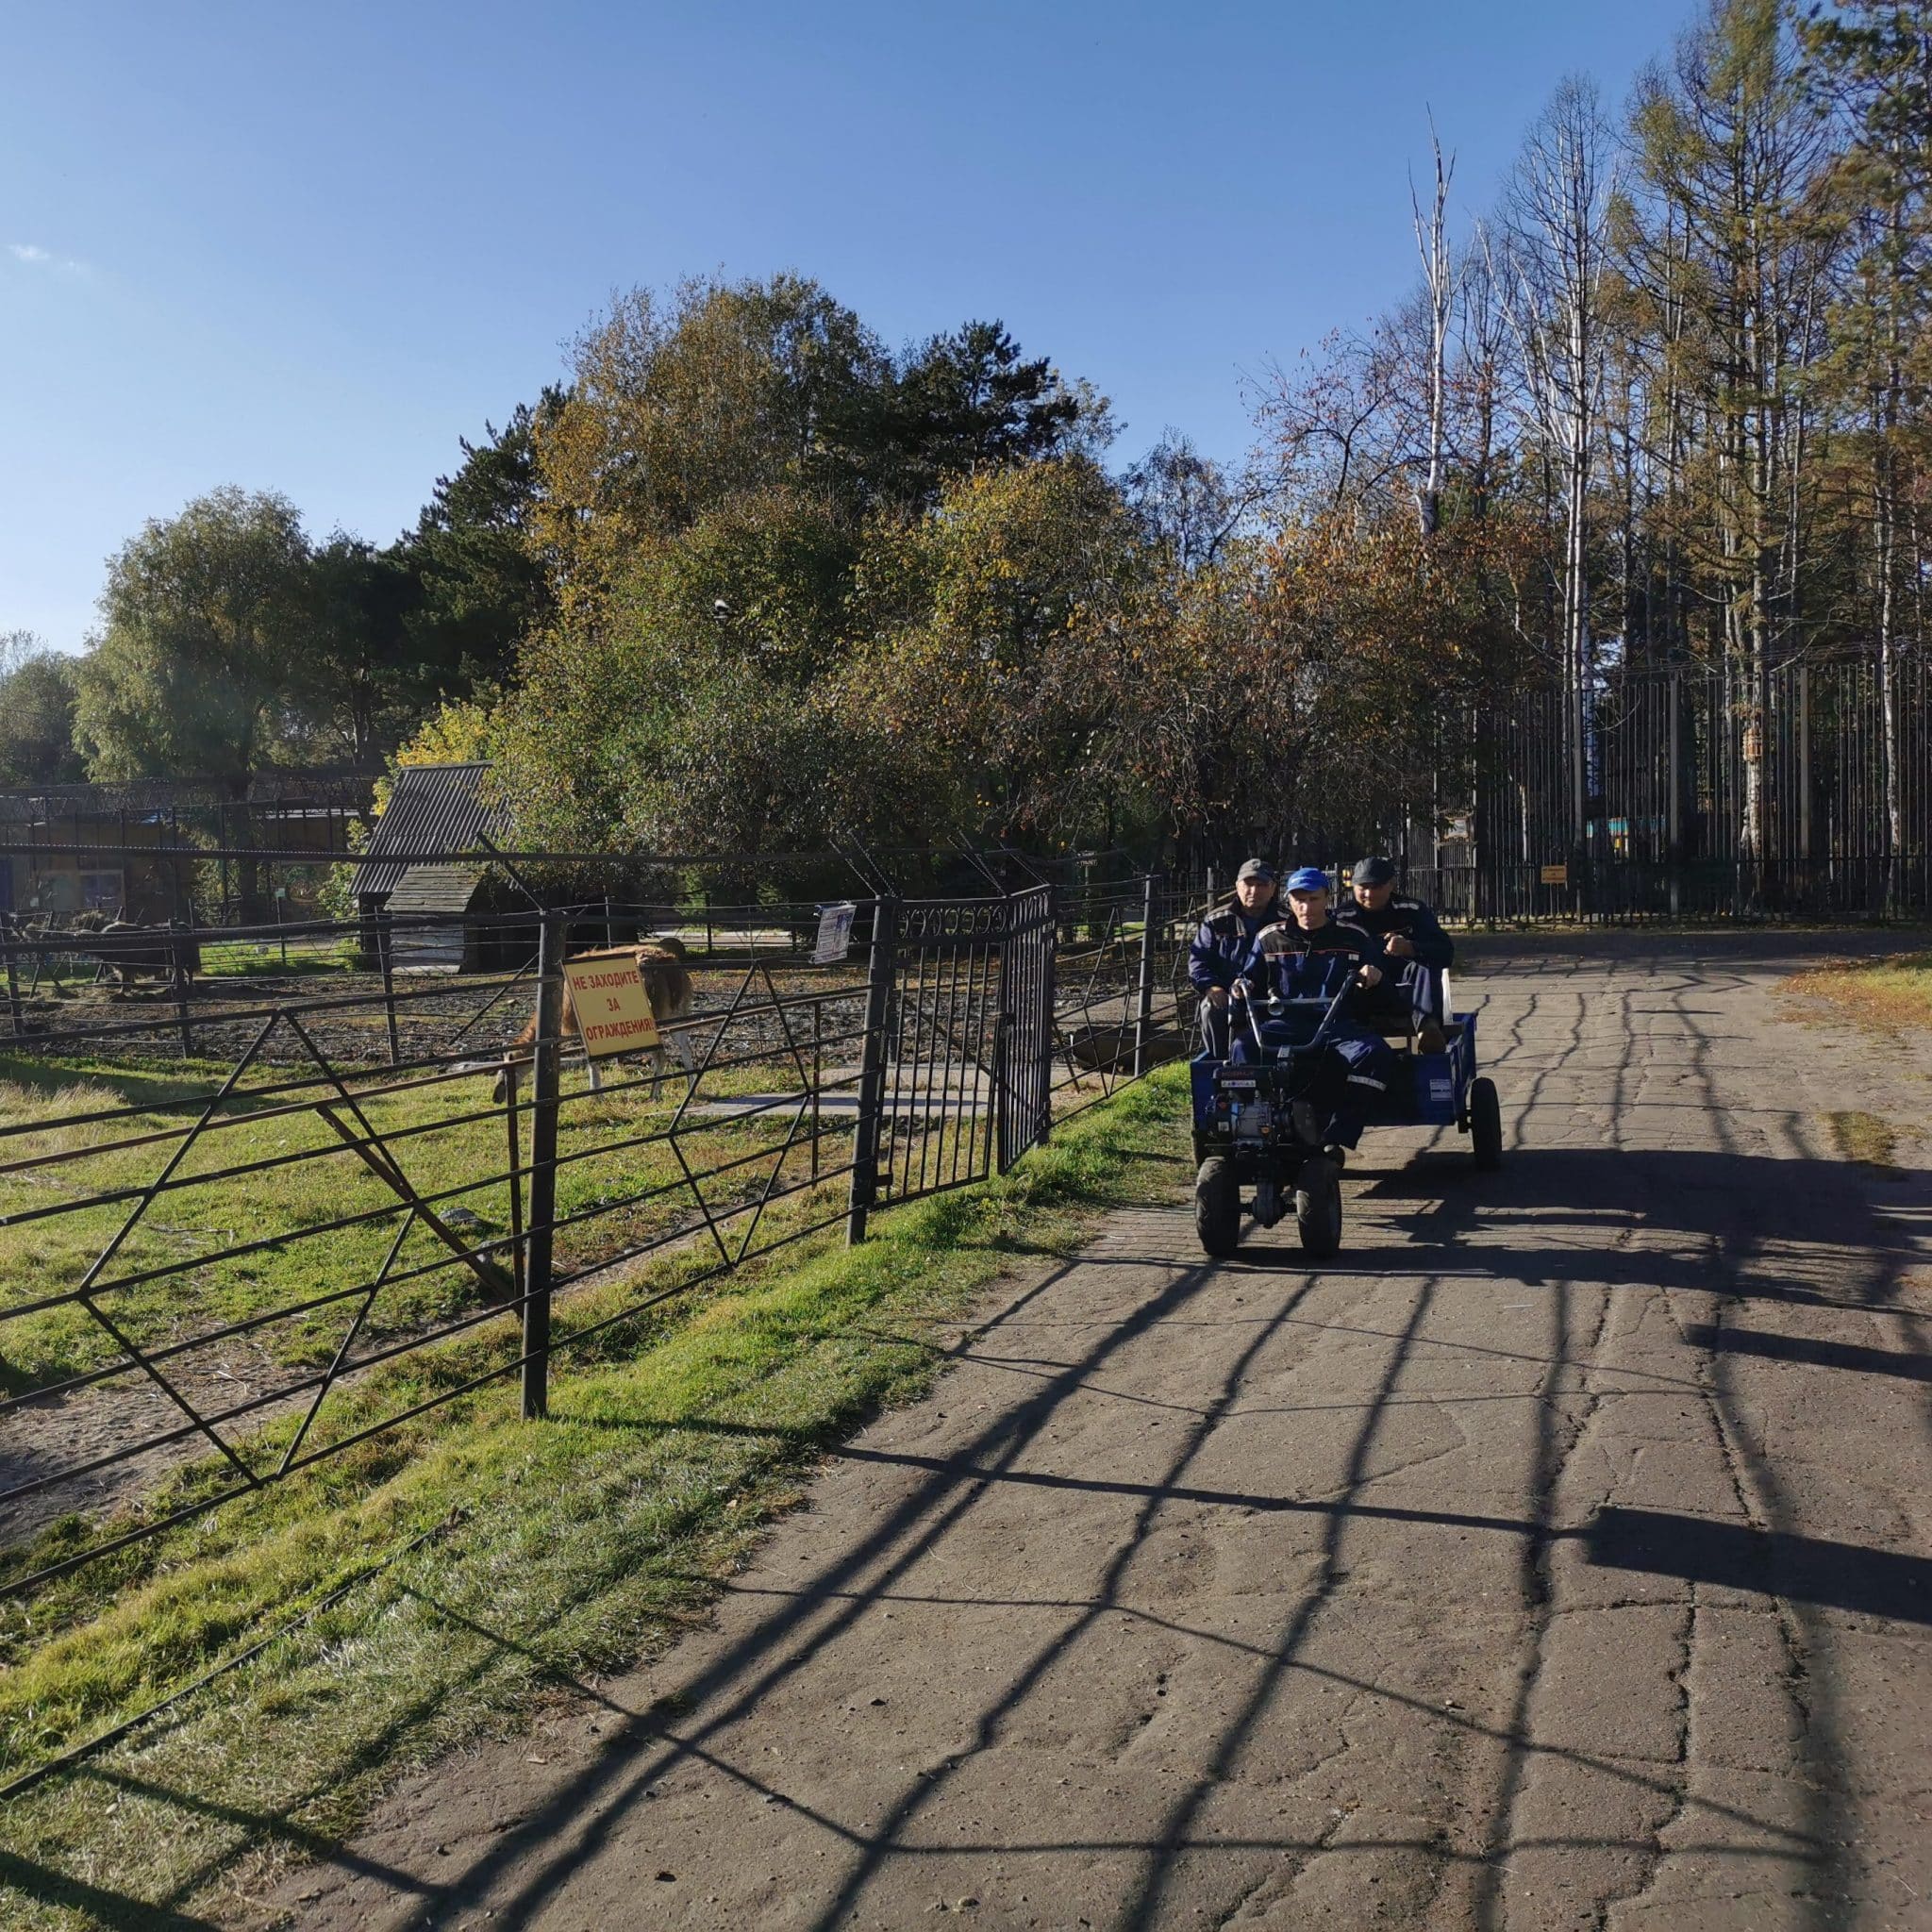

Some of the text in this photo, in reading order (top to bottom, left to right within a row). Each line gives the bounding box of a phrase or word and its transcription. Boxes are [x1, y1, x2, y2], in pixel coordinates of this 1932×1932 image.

[573, 970, 640, 991] НЕ ЗАХОДИТЕ
[607, 997, 621, 1012] ЗА
[586, 1018, 655, 1041] ОГРАЖДЕНИЯ!
